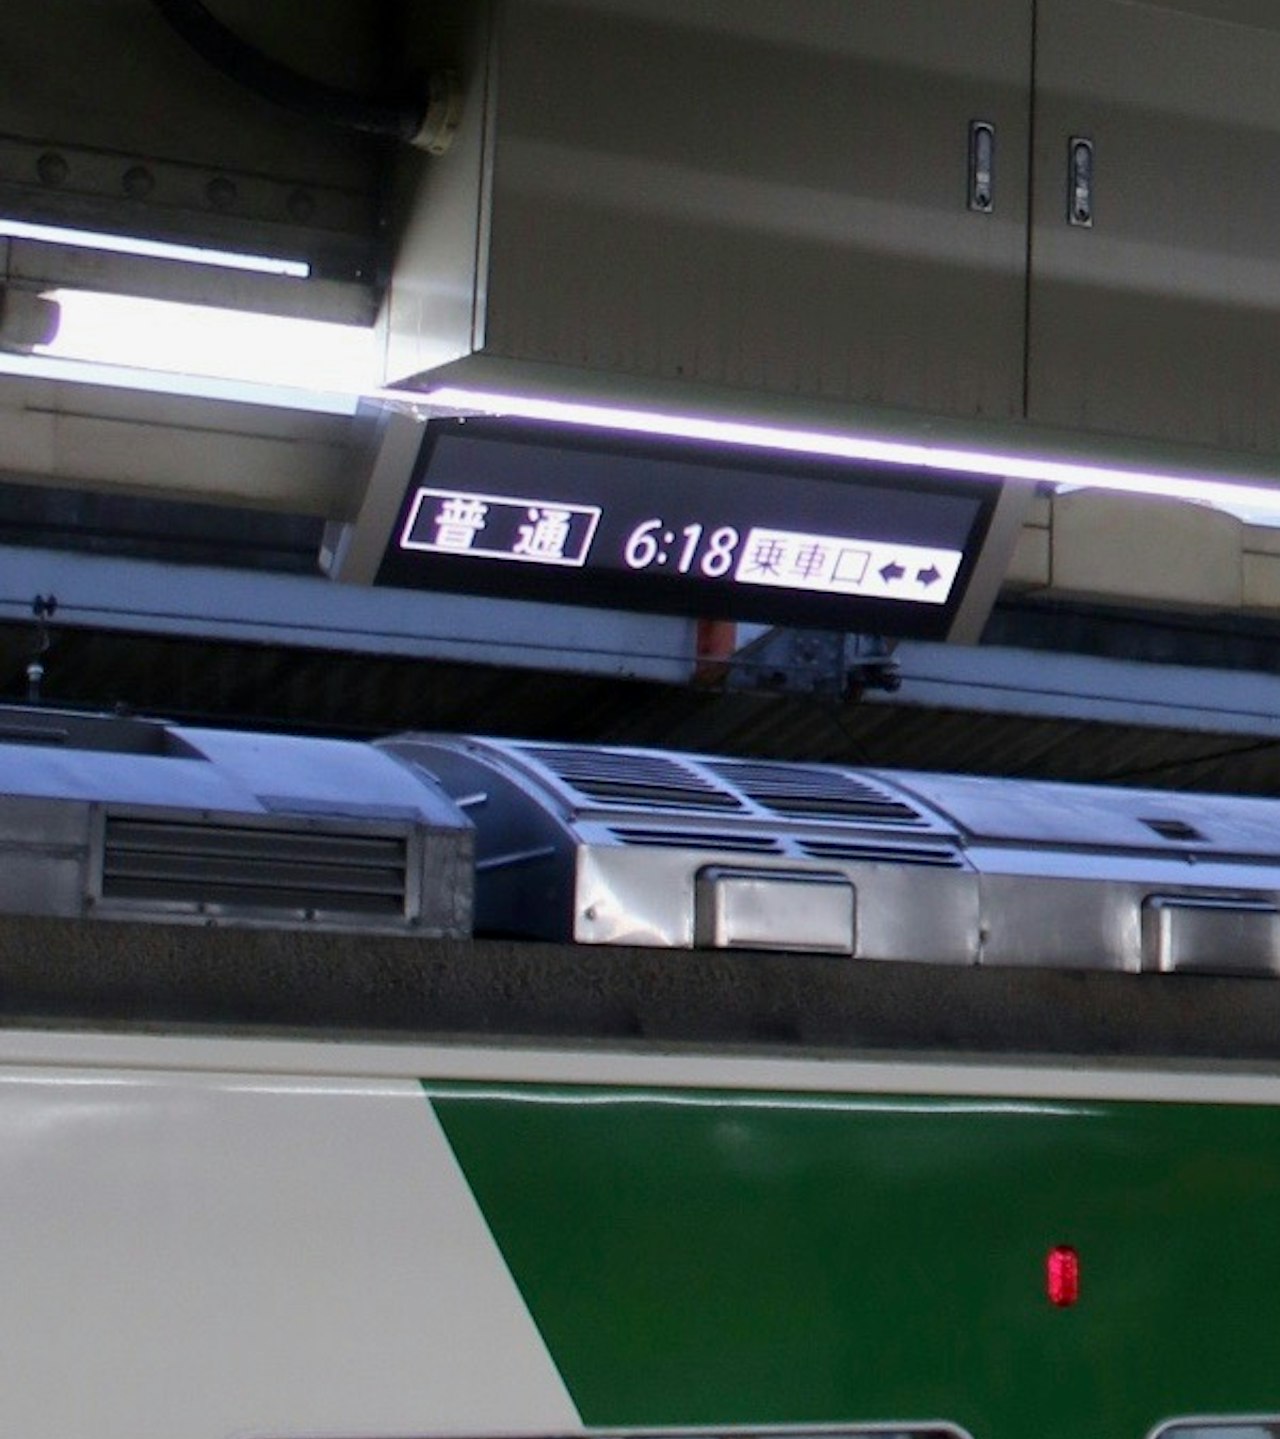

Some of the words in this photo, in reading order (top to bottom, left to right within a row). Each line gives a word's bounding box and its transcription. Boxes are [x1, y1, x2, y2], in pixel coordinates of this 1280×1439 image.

[434, 498, 574, 560] 普通
[623, 518, 740, 578] 6:18
[749, 536, 874, 586] 乗車口
